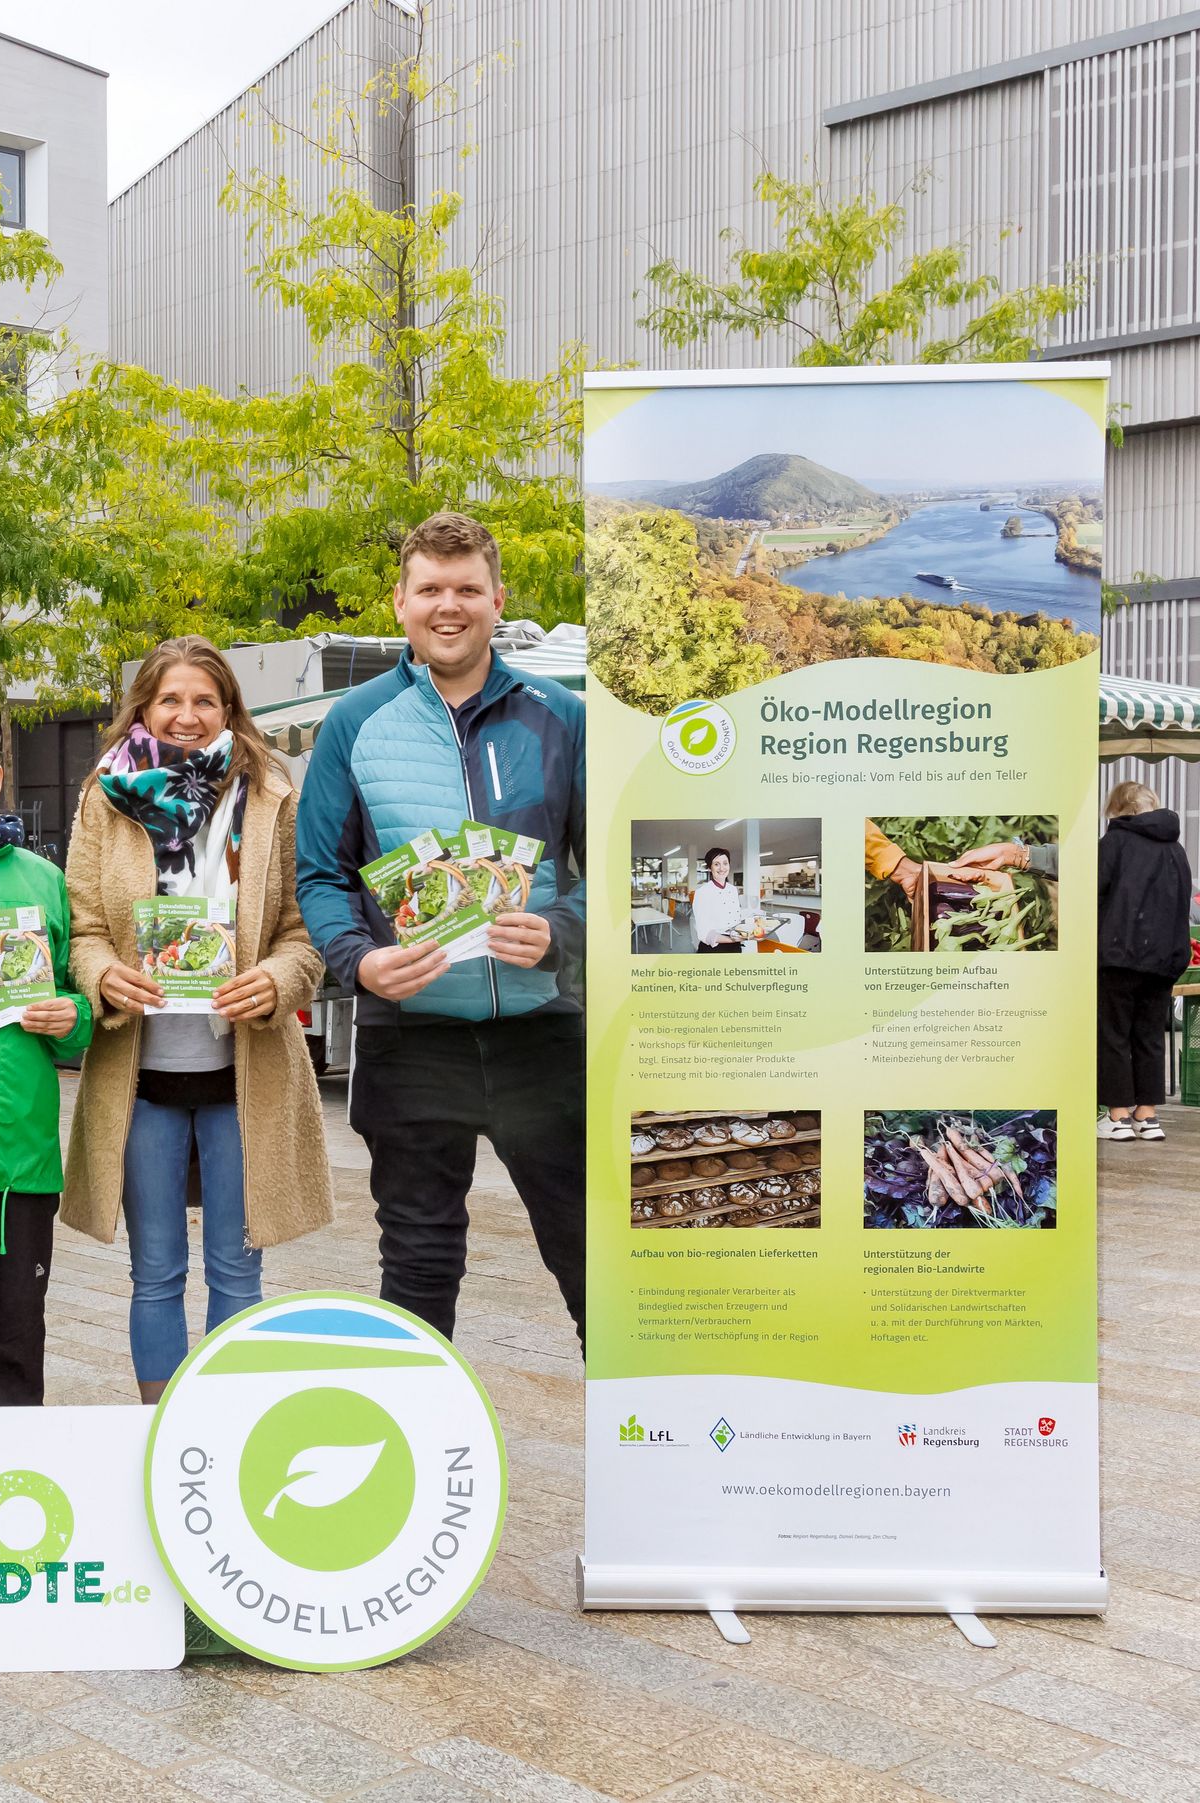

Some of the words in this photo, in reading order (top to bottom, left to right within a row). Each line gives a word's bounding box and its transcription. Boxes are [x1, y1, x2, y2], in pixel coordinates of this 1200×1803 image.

[761, 696, 992, 725] Öko-Modellregion
[668, 720, 730, 769] ÖKO-MODELLREGIONEN
[761, 732, 846, 760] Region
[857, 731, 1009, 759] Regensburg
[761, 773, 788, 783] Alles
[792, 772, 866, 785] bio-regional:
[870, 772, 894, 782] Vom
[899, 771, 921, 781] Feld
[926, 771, 943, 781] bis
[947, 770, 966, 781] auf
[970, 770, 991, 780] den
[996, 770, 1027, 780] Teller
[631, 969, 655, 977] Mehr
[658, 968, 721, 978] bio-regionale
[724, 967, 785, 976] Lebensmittel
[789, 967, 798, 976] in
[865, 967, 933, 977] Unterstützung
[936, 966, 959, 975] beim
[963, 966, 997, 974] Aufbau
[631, 984, 676, 993] Kantinen,
[679, 983, 702, 992] Kita-
[705, 983, 722, 992] und
[725, 982, 808, 993] Schulverpflegung
[885, 981, 1009, 992] Erzeuger-Gemeinschaften
[639, 1011, 699, 1020] Unterstützung
[718, 1010, 748, 1018] Küchen
[872, 1010, 918, 1018] Bündelung
[921, 1009, 974, 1017] bestehender
[978, 1009, 1047, 1018] Bio-Erzeugnisse
[657, 1026, 718, 1035] bio-regionalen
[721, 1025, 782, 1033] Lebensmitteln
[872, 1024, 884, 1032] für
[887, 1024, 910, 1032] einen
[913, 1024, 970, 1033] erfolgreichen
[973, 1024, 1003, 1032] Absatz
[639, 1041, 685, 1050] Workshops
[688, 1040, 700, 1048] für
[703, 1040, 773, 1049] Küchenleitungen
[872, 1041, 907, 1049] Nutzung
[910, 1040, 967, 1049] gemeinsamer
[639, 1056, 658, 1065] bzgl.
[661, 1056, 691, 1064] Einsatz
[694, 1055, 753, 1065] bio-regionaler
[757, 1055, 795, 1063] Produkte
[872, 1055, 942, 1064] Miteinbeziehung
[962, 1054, 1015, 1062] Verbraucher
[639, 1072, 686, 1081] Vernetzung
[705, 1071, 766, 1080] bio-regionalen
[770, 1070, 818, 1078] Landwirten
[631, 1249, 665, 1258] Aufbau
[687, 1249, 756, 1259] bio-regionalen
[759, 1249, 818, 1258] Lieferketten
[863, 1250, 932, 1260] Unterstützung
[935, 1250, 950, 1258] der
[863, 1265, 914, 1275] regionalen
[917, 1264, 985, 1274] Bio-Landwirte
[639, 1288, 685, 1297] Einbindung
[688, 1288, 730, 1297] regionaler
[732, 1288, 780, 1296] Verarbeiter
[783, 1288, 796, 1296] als
[871, 1289, 932, 1298] Unterstützung
[935, 1289, 948, 1297] der
[952, 1289, 1026, 1297] Direktvermarkter
[639, 1303, 682, 1312] Bindeglied
[726, 1303, 768, 1311] Erzeugern
[950, 1304, 1026, 1312] Landwirtschaften
[639, 1317, 751, 1325] Vermarktern/Verbrauchern
[925, 1319, 983, 1328] Durchführung
[1005, 1319, 1042, 1328] Märkten,
[638, 1332, 675, 1342] Stärkung
[694, 1332, 759, 1341] Wertschöpfung
[789, 1333, 819, 1342] Region
[871, 1334, 910, 1343] Hoftagen
[913, 1334, 928, 1342] etc.
[650, 1431, 673, 1441] LfL
[923, 1427, 966, 1435] Landkreis
[1005, 1428, 1033, 1436] STADT
[781, 1432, 830, 1441] Entwicklung
[843, 1433, 871, 1443] Bayern
[923, 1437, 979, 1447] Regensburg
[1004, 1439, 1068, 1447] REGENSBURG
[722, 1484, 951, 1499] www.oekomodellregionen.bayern
[179, 1446, 473, 1635] ÖKO-MODELLREGIONEN
